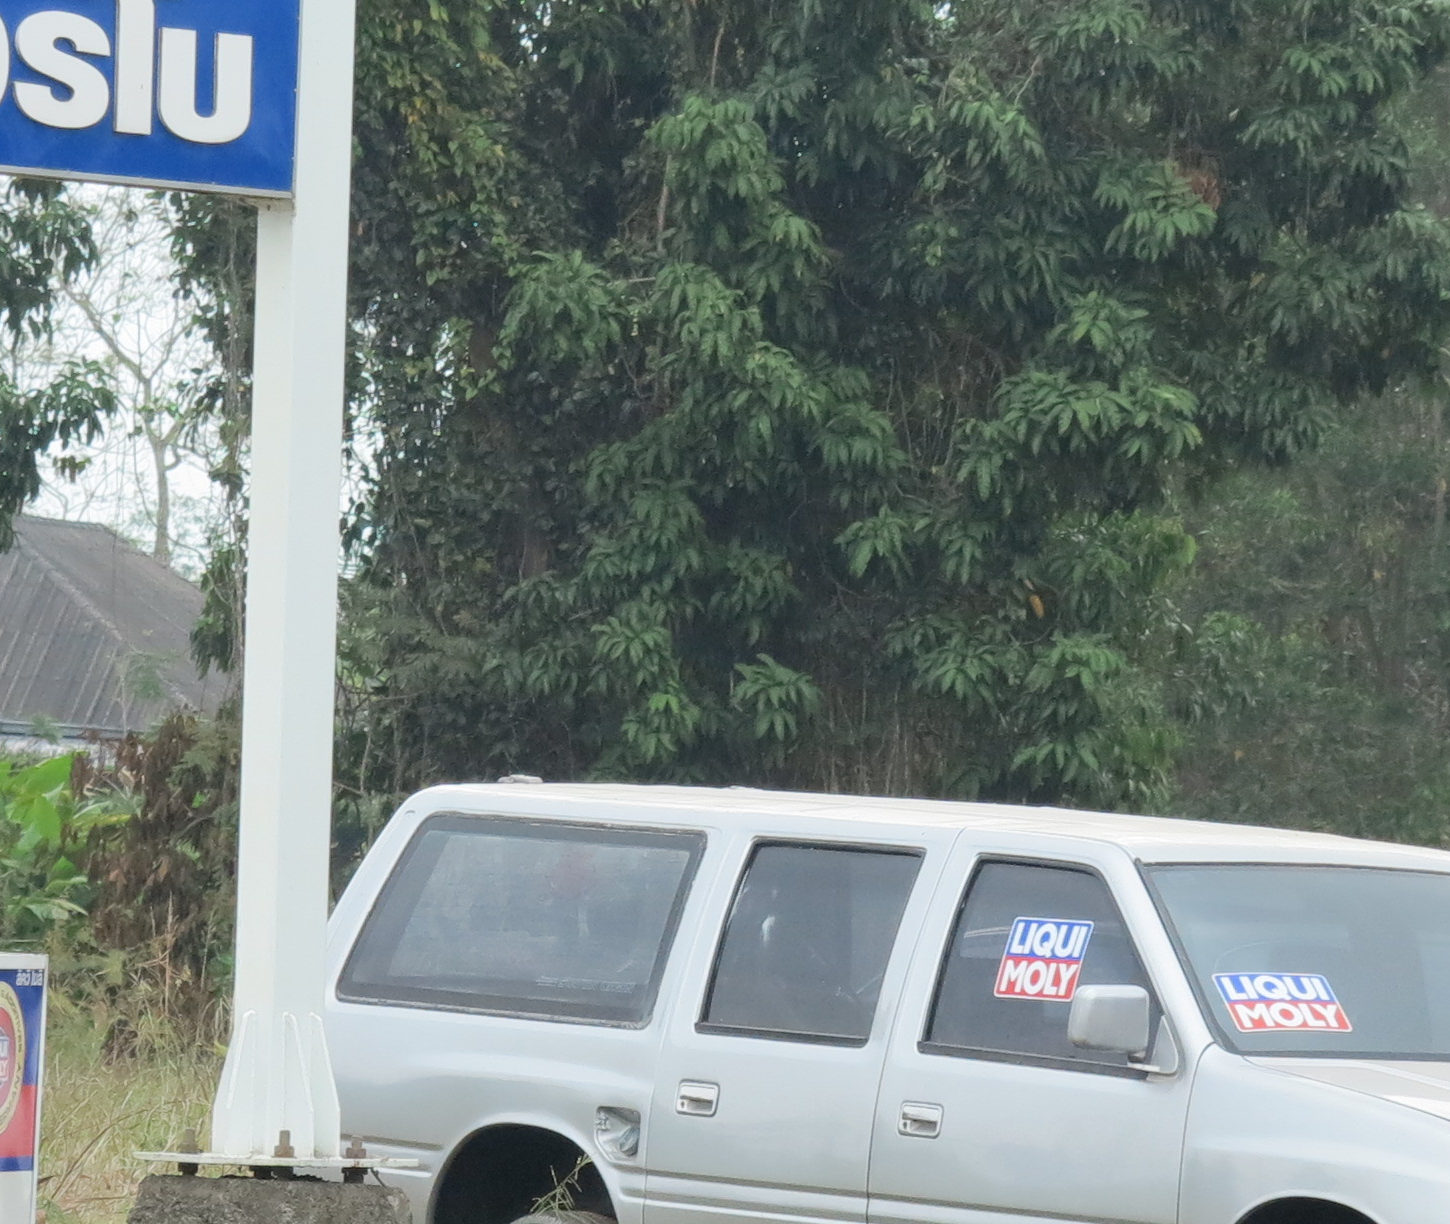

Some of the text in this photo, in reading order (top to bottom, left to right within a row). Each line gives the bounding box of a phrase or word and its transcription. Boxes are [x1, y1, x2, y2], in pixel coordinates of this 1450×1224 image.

[1010, 921, 1092, 959] LIQUI
[999, 959, 1079, 996] MOLY
[1220, 974, 1331, 1002] LIQUI
[1237, 1002, 1340, 1029] MOLY
